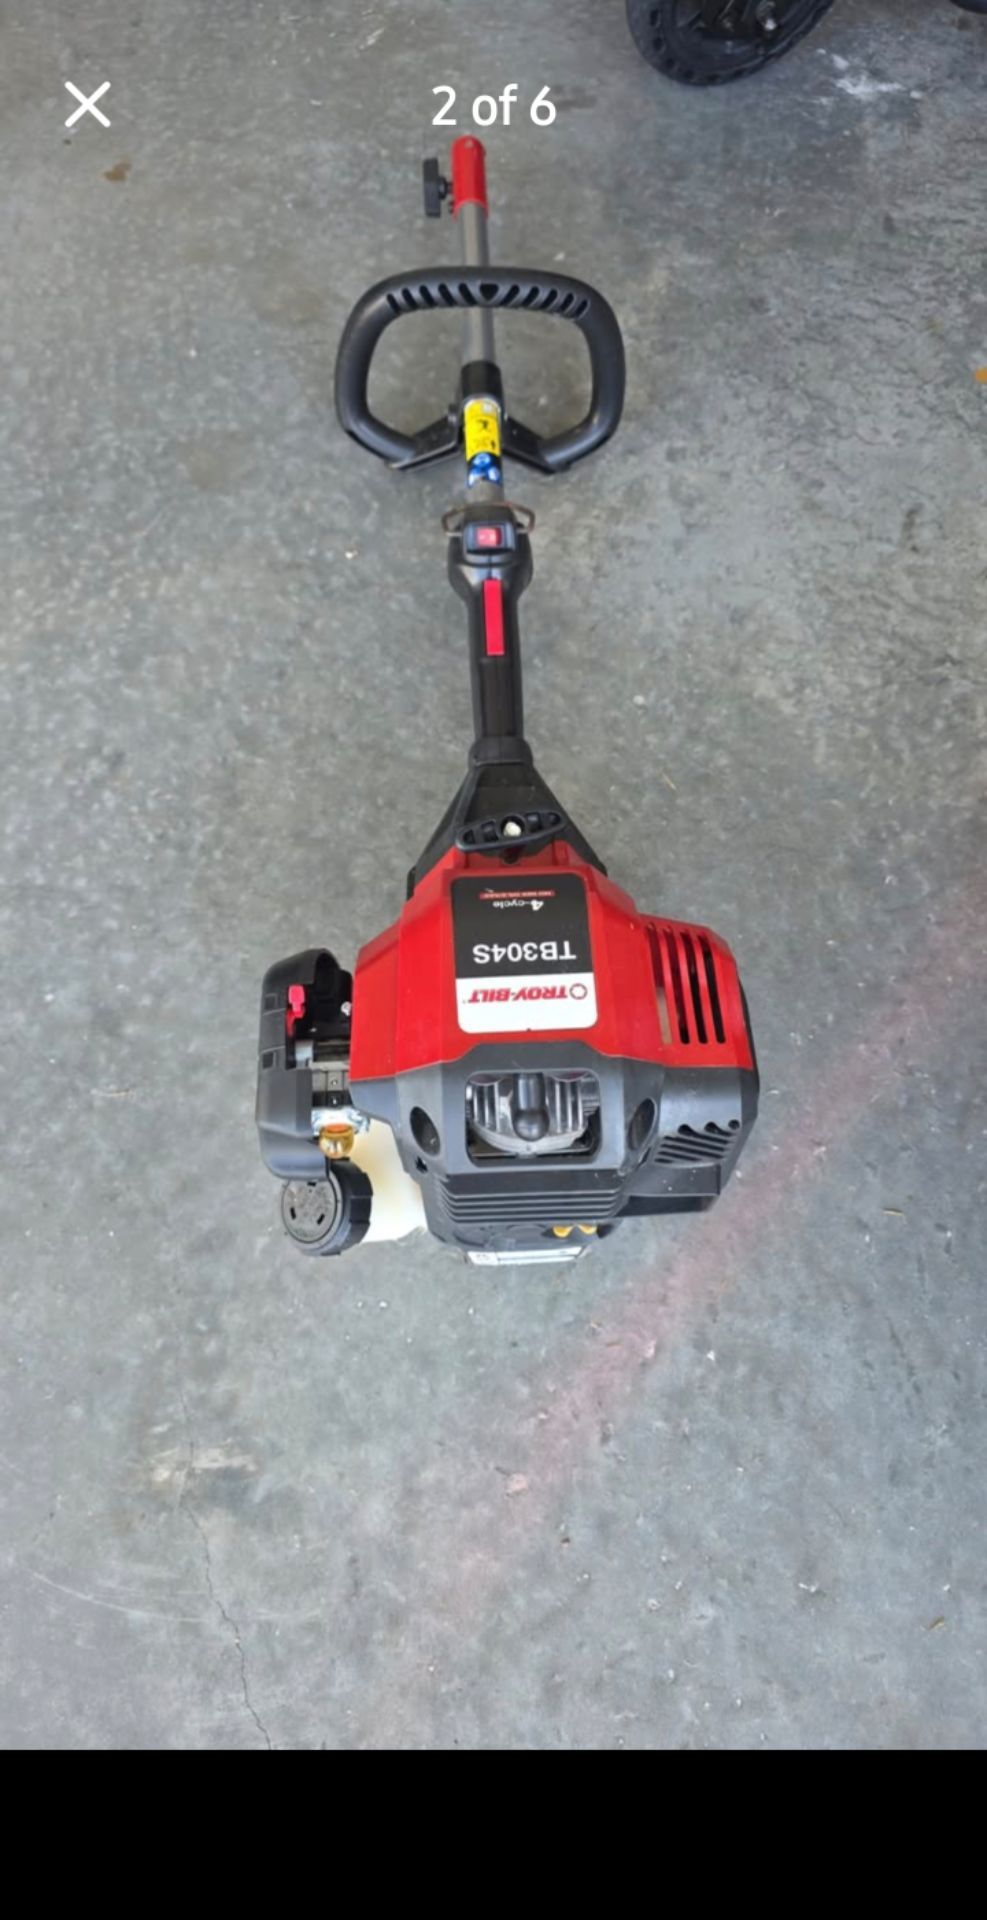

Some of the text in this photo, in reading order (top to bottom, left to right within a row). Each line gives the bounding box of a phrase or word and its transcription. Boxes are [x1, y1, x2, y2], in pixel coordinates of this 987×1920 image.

[492, 898, 544, 911] 4-cycle
[472, 940, 577, 965] TB304S
[468, 985, 568, 1004] TROY-BILT
